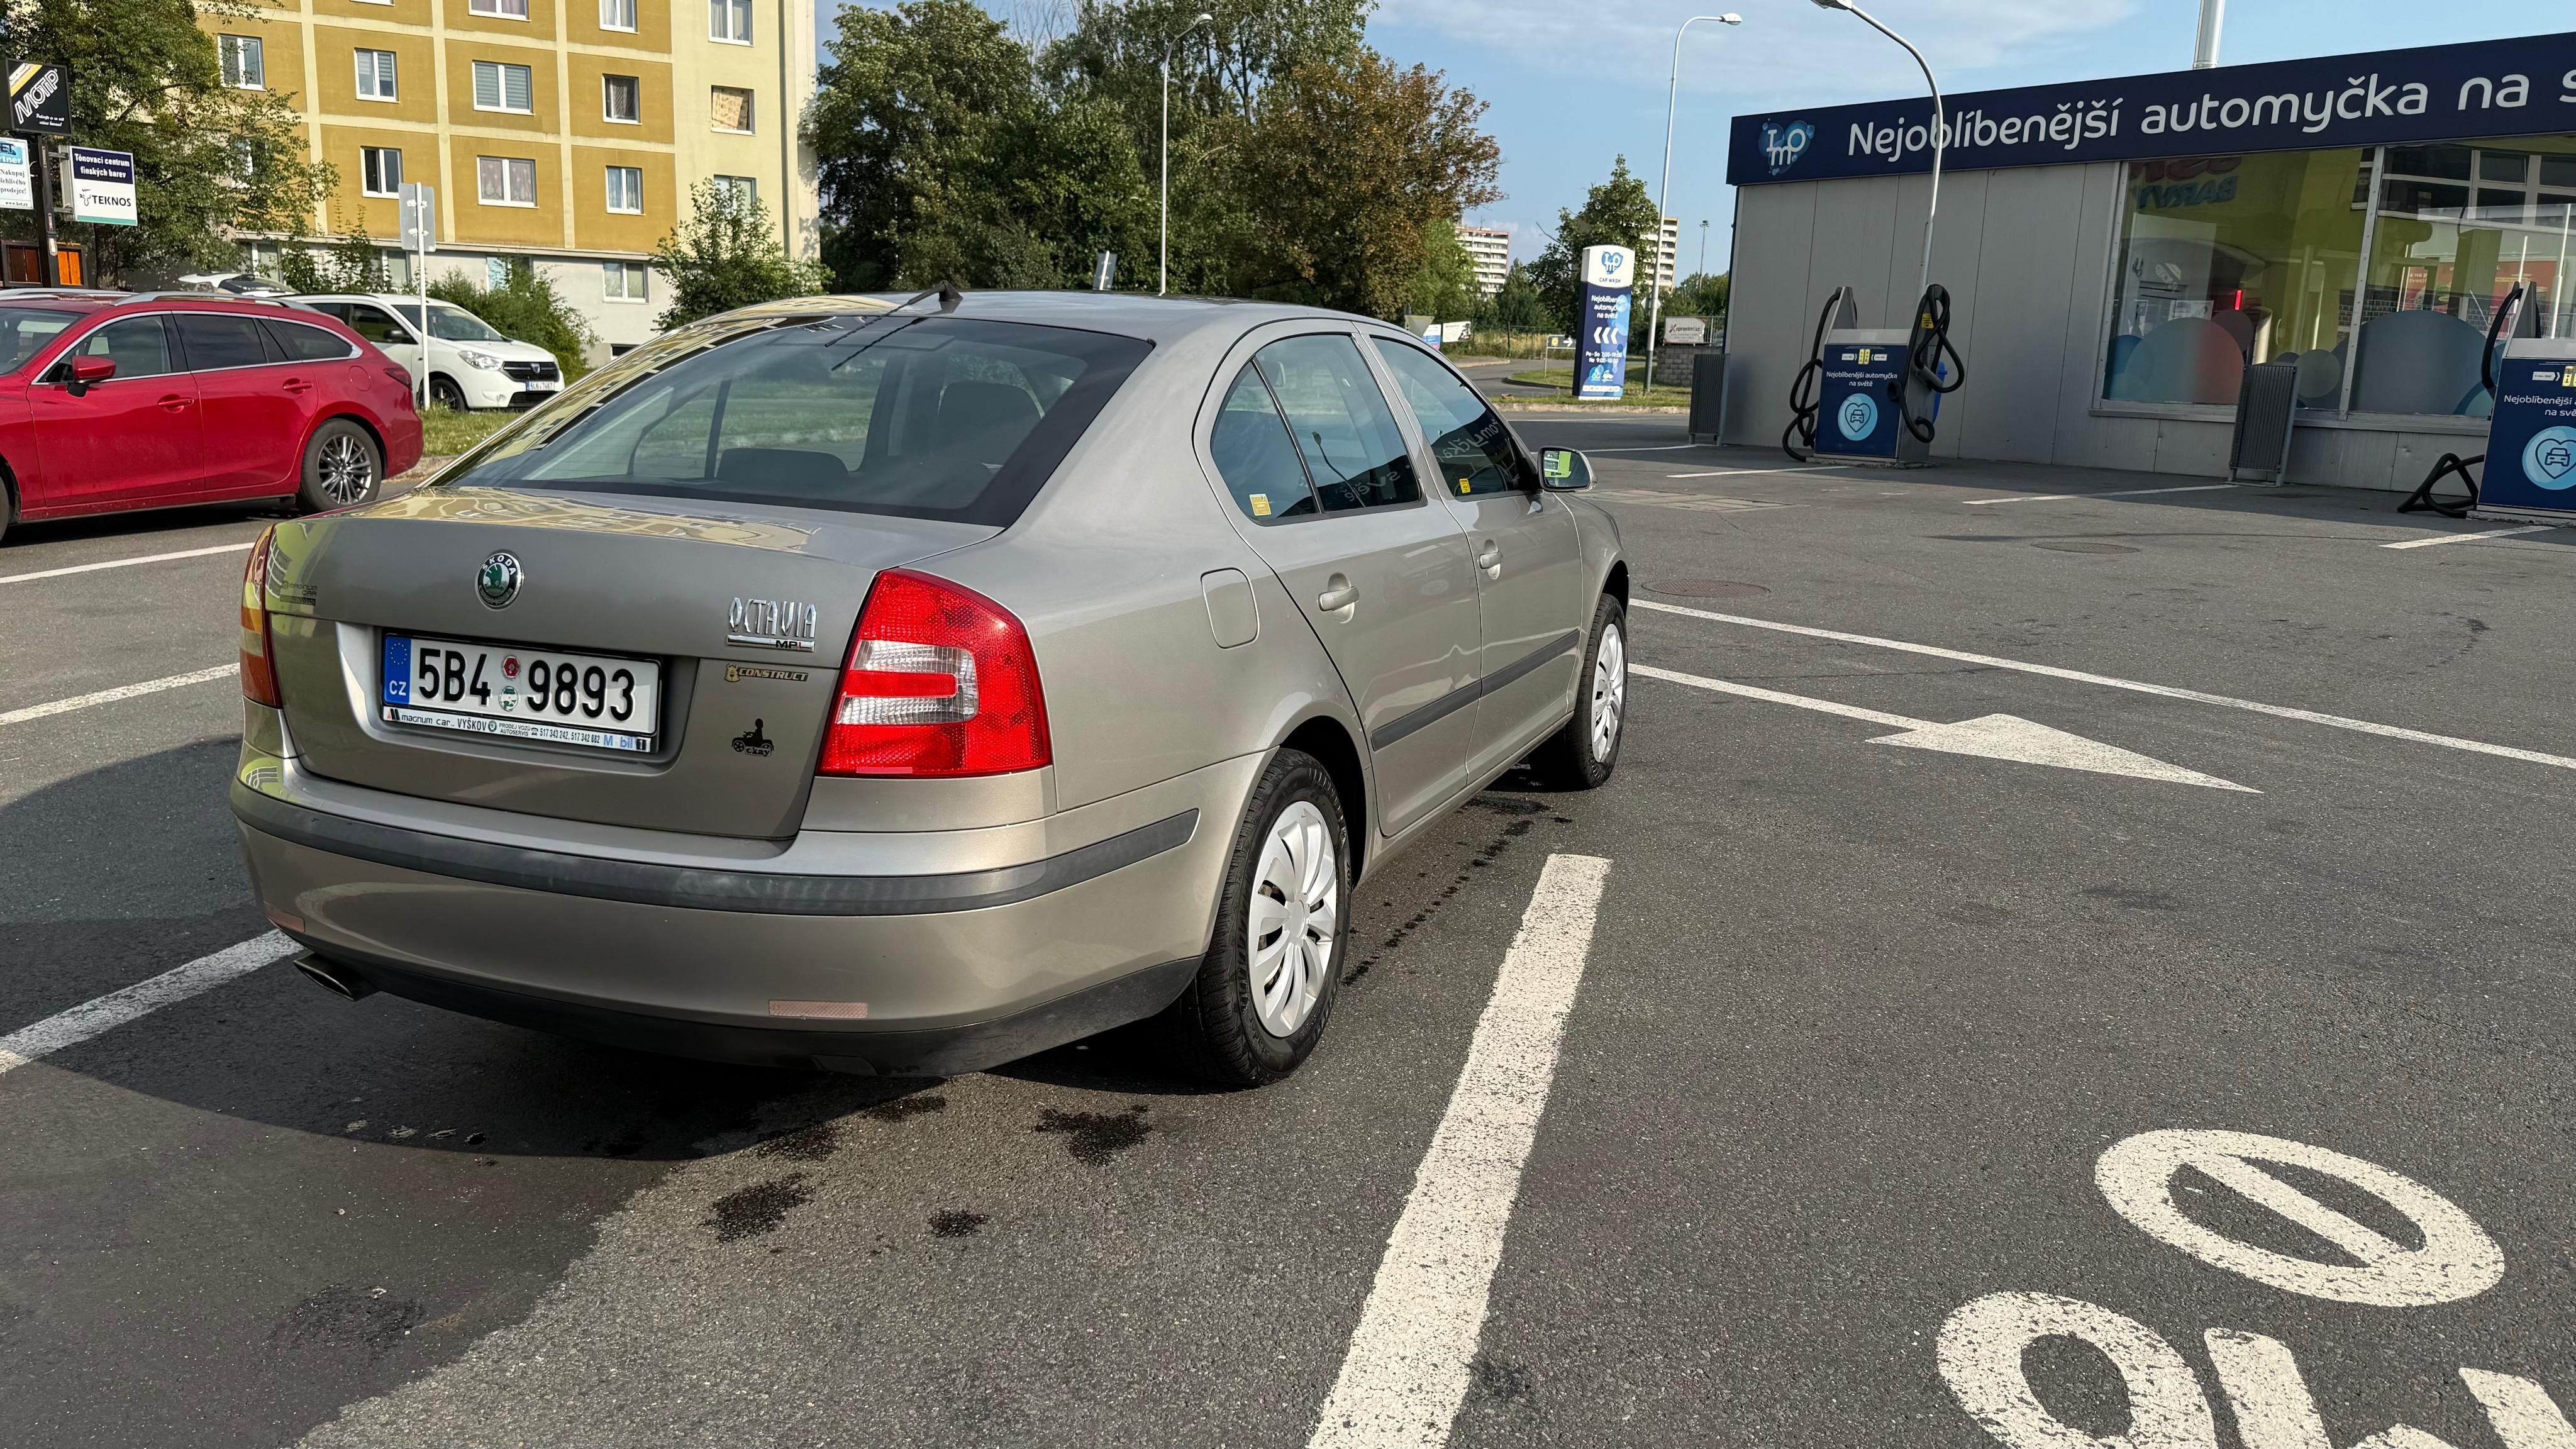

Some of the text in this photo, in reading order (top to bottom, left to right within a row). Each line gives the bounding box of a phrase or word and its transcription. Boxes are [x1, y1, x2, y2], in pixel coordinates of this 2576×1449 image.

[1848, 97, 2124, 162] Nejoblíbenější
[2140, 73, 2429, 133] automyčka
[2457, 73, 2529, 111] na
[104, 158, 130, 167] centrum
[80, 166, 126, 178] finských barev
[92, 194, 131, 207] TEKNOS
[2504, 394, 2573, 406] Nejoblíbenější
[729, 597, 817, 638] OCTAVIA
[738, 667, 809, 682] CONSTRUCT
[389, 680, 408, 697] CZ
[419, 647, 636, 723] 5B4 9893
[401, 714, 433, 725] magnum
[457, 717, 487, 731] VYŠKOV
[500, 728, 529, 737] AUTOSERVIS
[540, 728, 549, 737] 517
[550, 729, 558, 739] 343
[571, 731, 580, 741] 517
[580, 733, 590, 742] 342
[591, 734, 600, 743] 882
